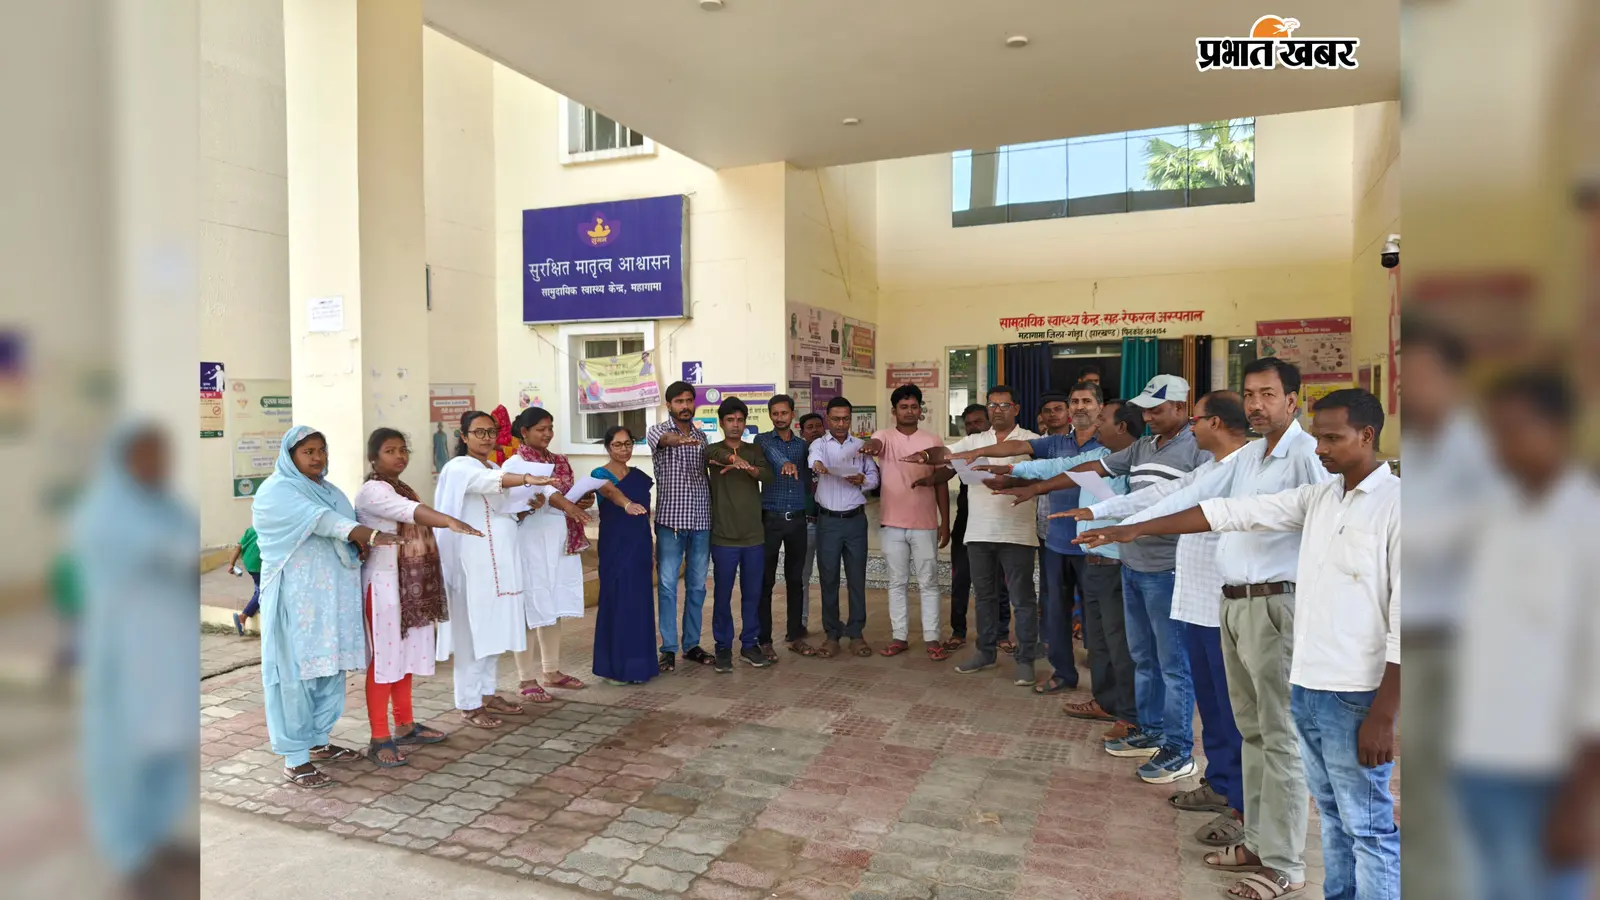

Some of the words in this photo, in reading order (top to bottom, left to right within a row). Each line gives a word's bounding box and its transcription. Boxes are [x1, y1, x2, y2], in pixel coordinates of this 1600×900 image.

[528, 258, 570, 282] सुरक्षित
[575, 258, 613, 279] मातृत्व
[618, 254, 671, 272] आश्वासन
[541, 284, 578, 300] सामुदायिक
[580, 285, 605, 296] स्वास्थ्य
[608, 281, 627, 295] केन्द्र,
[630, 282, 662, 293] महागामा
[1047, 314, 1080, 328] स्वास्थ्य
[1157, 310, 1205, 324] अस्पताल
